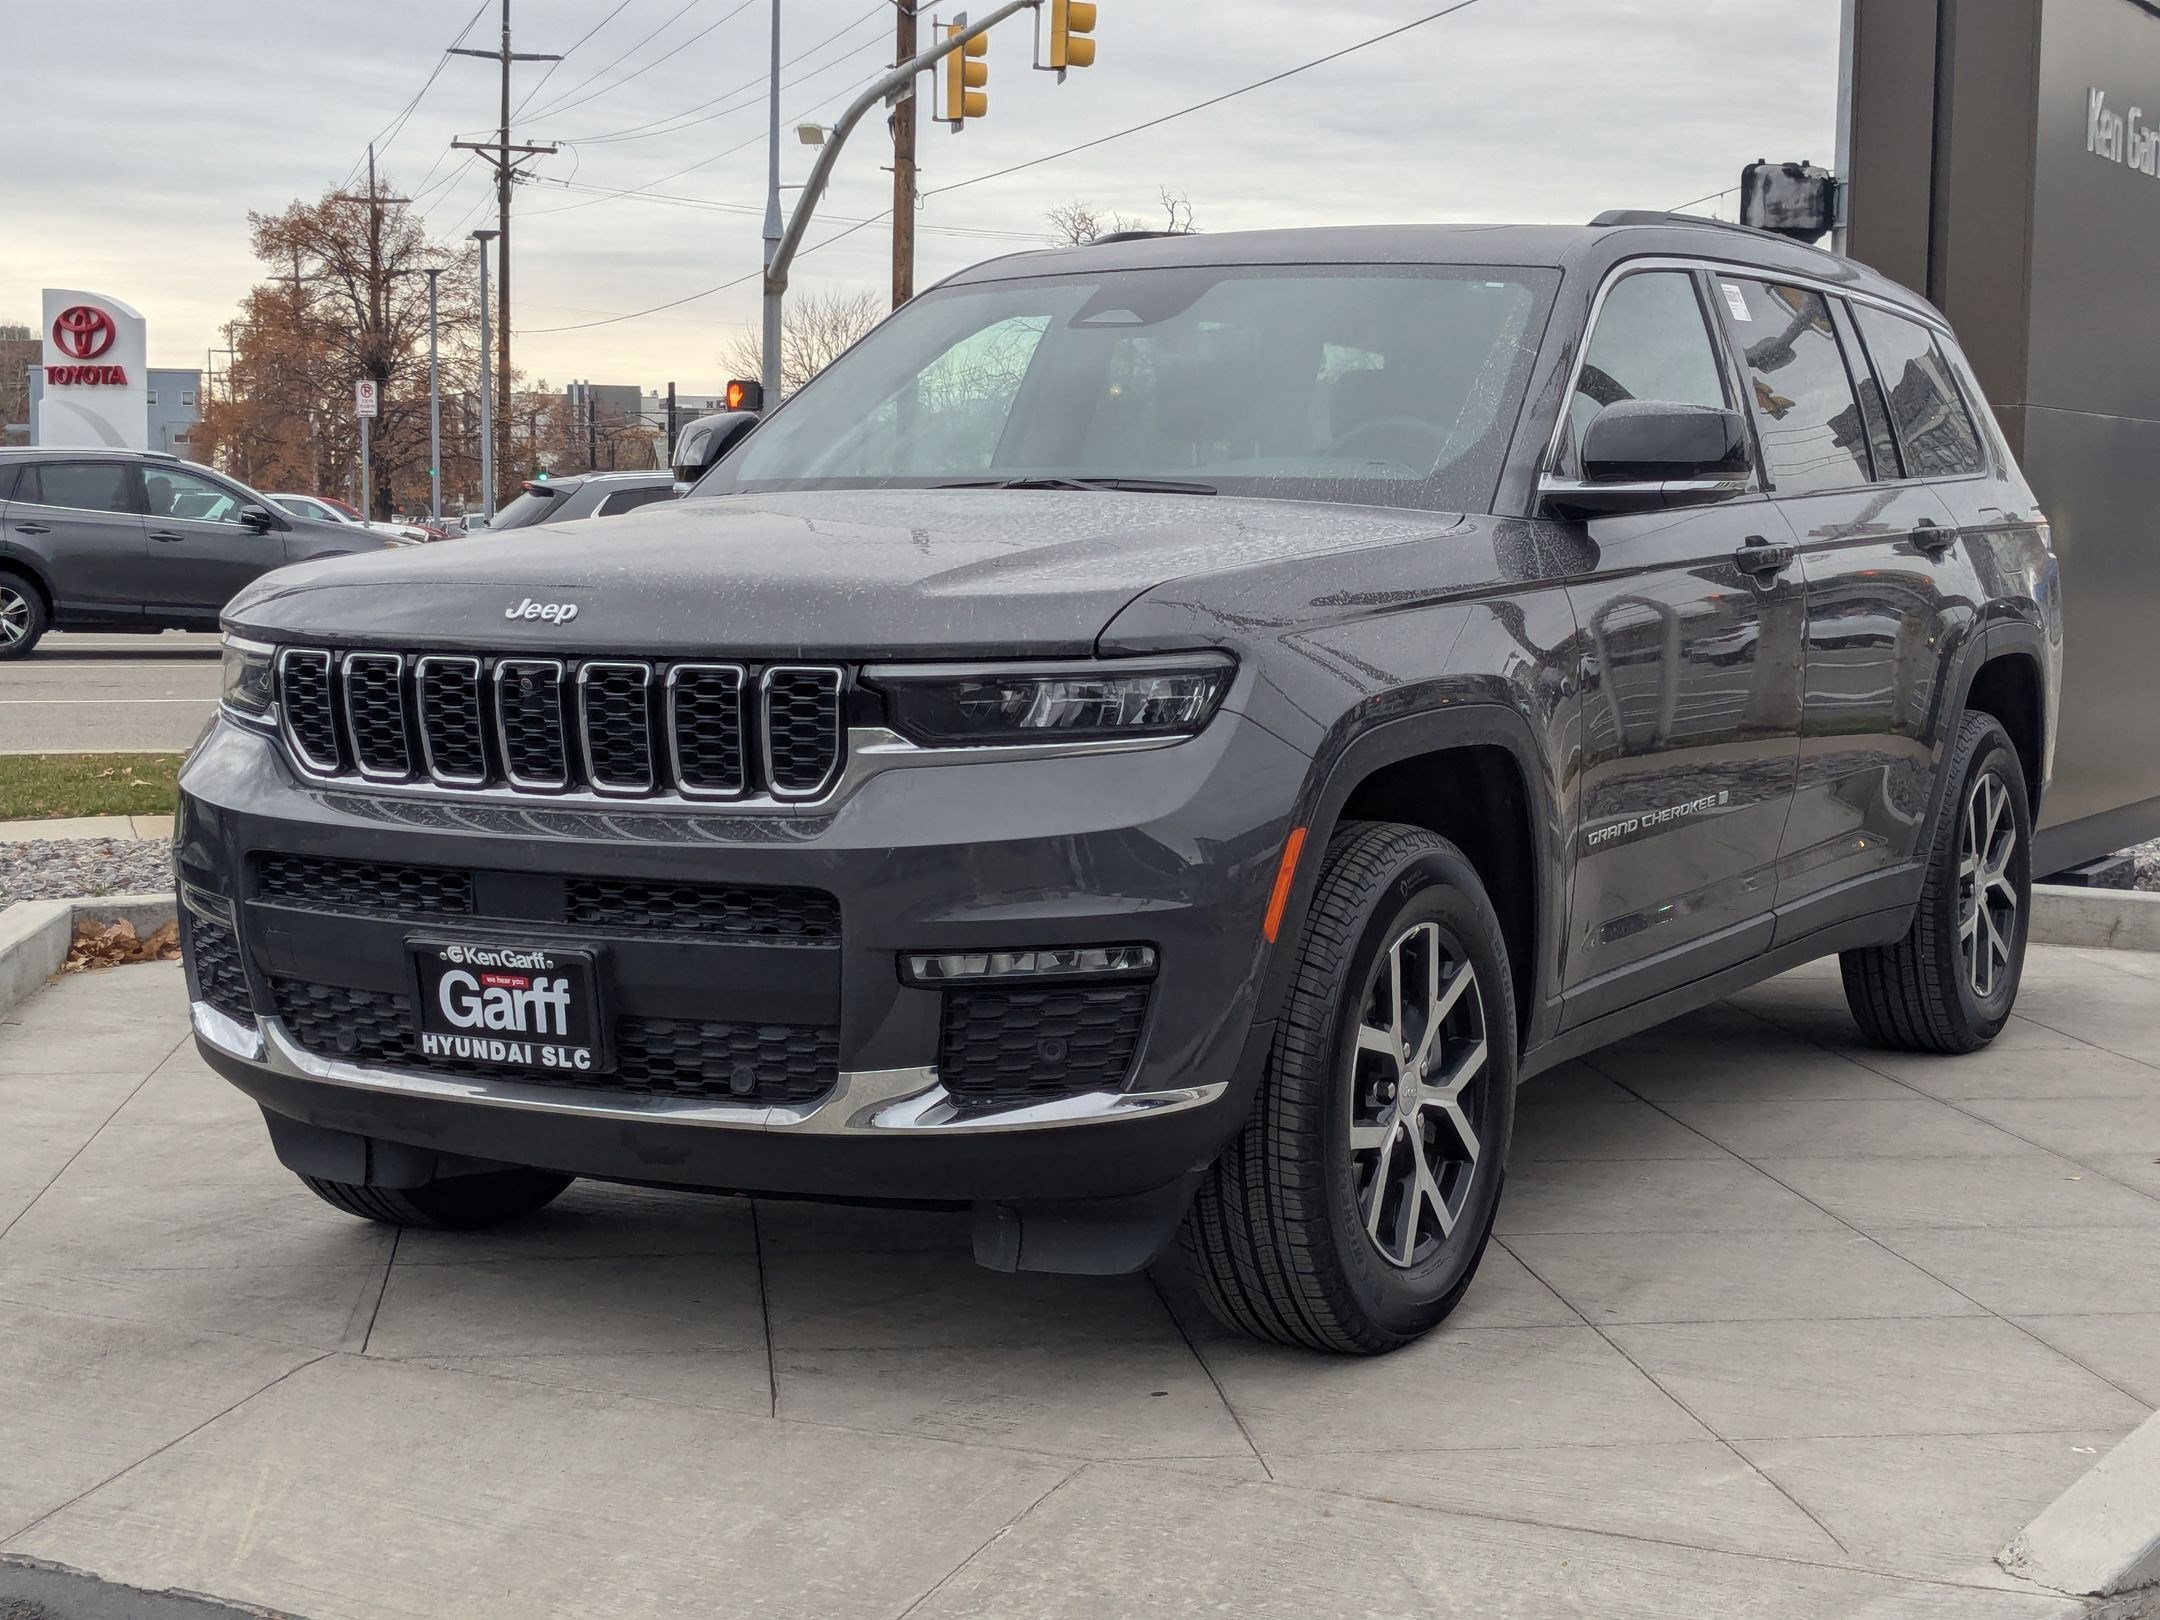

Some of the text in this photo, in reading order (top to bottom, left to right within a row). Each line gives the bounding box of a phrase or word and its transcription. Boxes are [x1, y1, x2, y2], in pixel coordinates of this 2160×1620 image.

[2087, 87, 2122, 163] Ken
[44, 366, 127, 385] TOYOTA
[505, 598, 579, 625] Jeep
[1588, 819, 1638, 846] GRAND
[1642, 795, 1717, 828] CHEROKEE
[486, 976, 524, 987] we hear you
[439, 969, 570, 1036] Garff
[422, 1034, 591, 1070] HYUNDAI SLC
